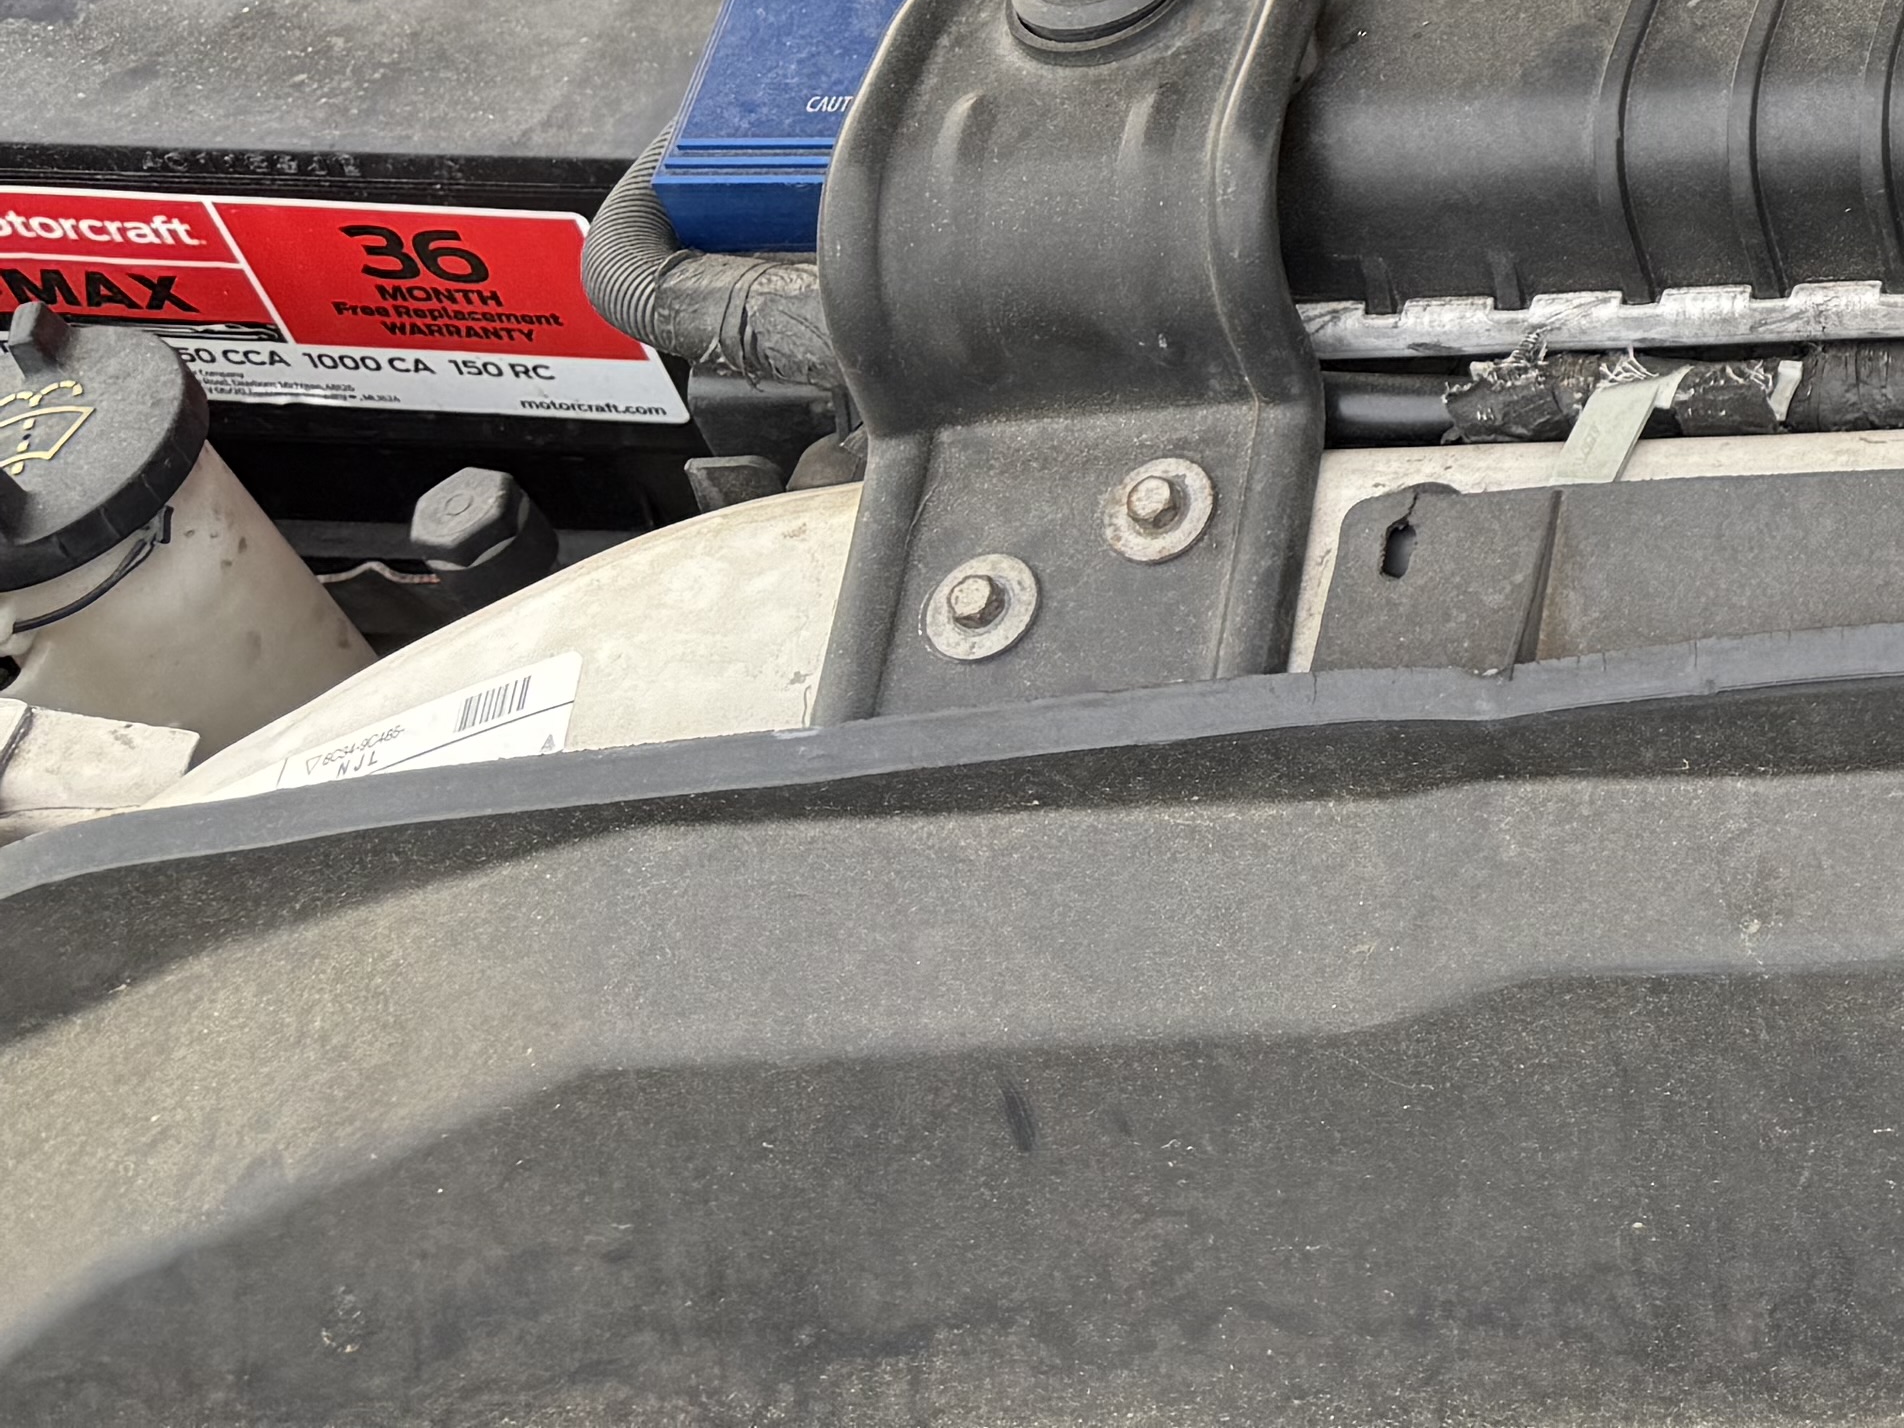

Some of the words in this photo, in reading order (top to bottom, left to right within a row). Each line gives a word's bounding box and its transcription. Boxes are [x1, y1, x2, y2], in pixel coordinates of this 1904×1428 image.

[806, 95, 855, 114] CAUT
[0, 210, 200, 246] torcraft
[340, 224, 488, 285] 36
[1, 267, 201, 314] MAX
[374, 283, 503, 309] MONTH
[331, 299, 409, 321] Free
[413, 304, 563, 330] Replacement
[381, 319, 535, 345] WARRANTY
[222, 348, 291, 368] CCA
[302, 352, 382, 372] 1000
[388, 355, 435, 376] CA
[448, 357, 504, 380] 150
[511, 361, 556, 382] RC
[520, 396, 667, 419] motorcraft.com
